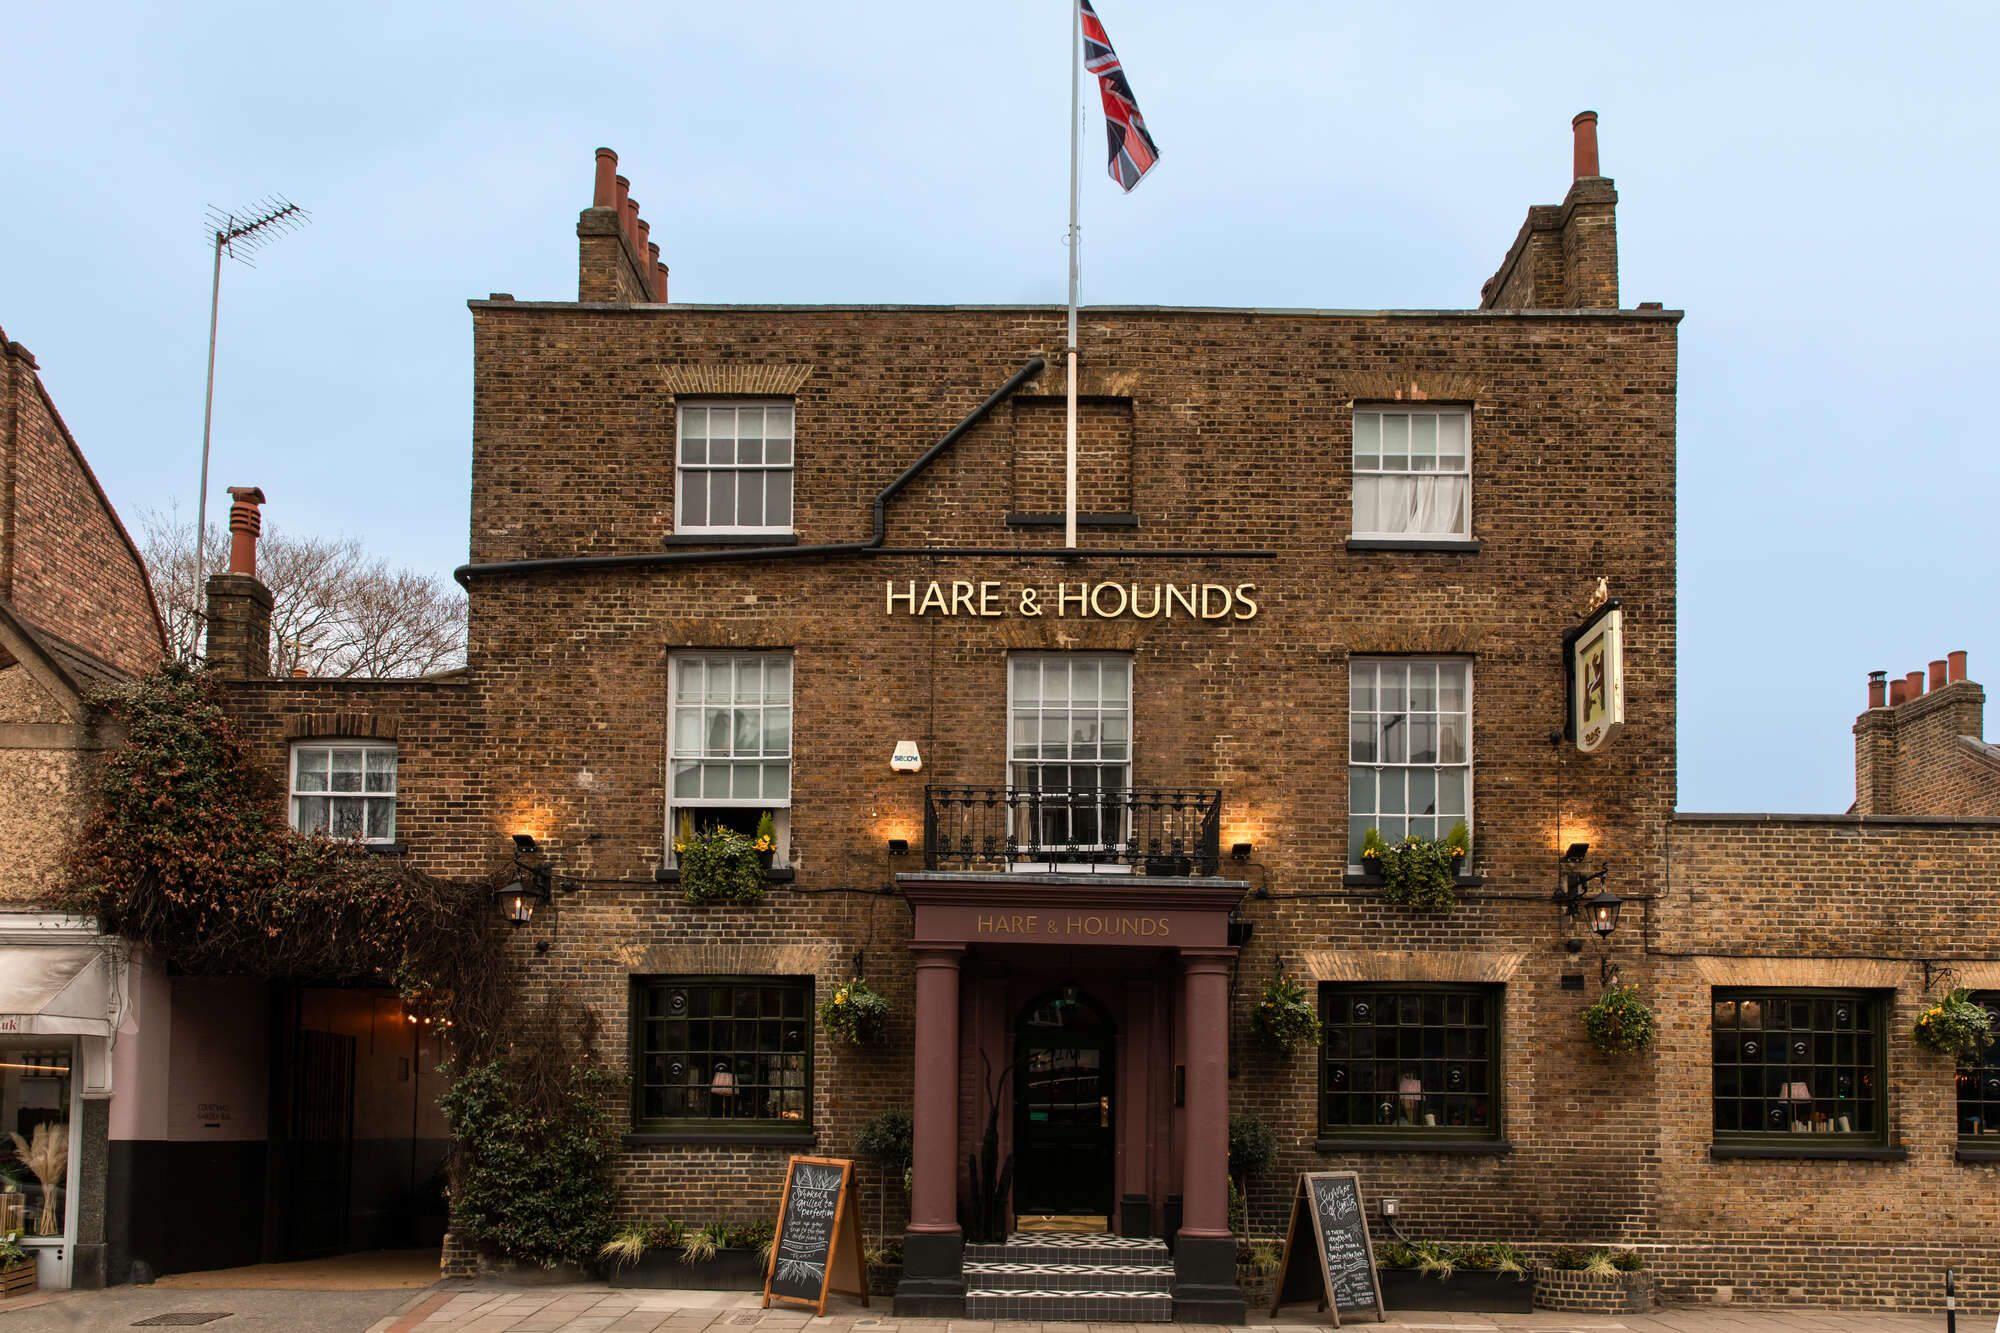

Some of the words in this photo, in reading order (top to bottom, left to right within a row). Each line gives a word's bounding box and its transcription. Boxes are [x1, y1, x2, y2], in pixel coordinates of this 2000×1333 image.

[886, 579, 1003, 617] HARE
[1018, 587, 1043, 617] &
[1058, 581, 1258, 620] HOUNDS
[976, 915, 1038, 935] HARE
[1047, 921, 1058, 935] &
[1065, 916, 1170, 937] HOUNDS
[796, 1199, 824, 1212] grilled
